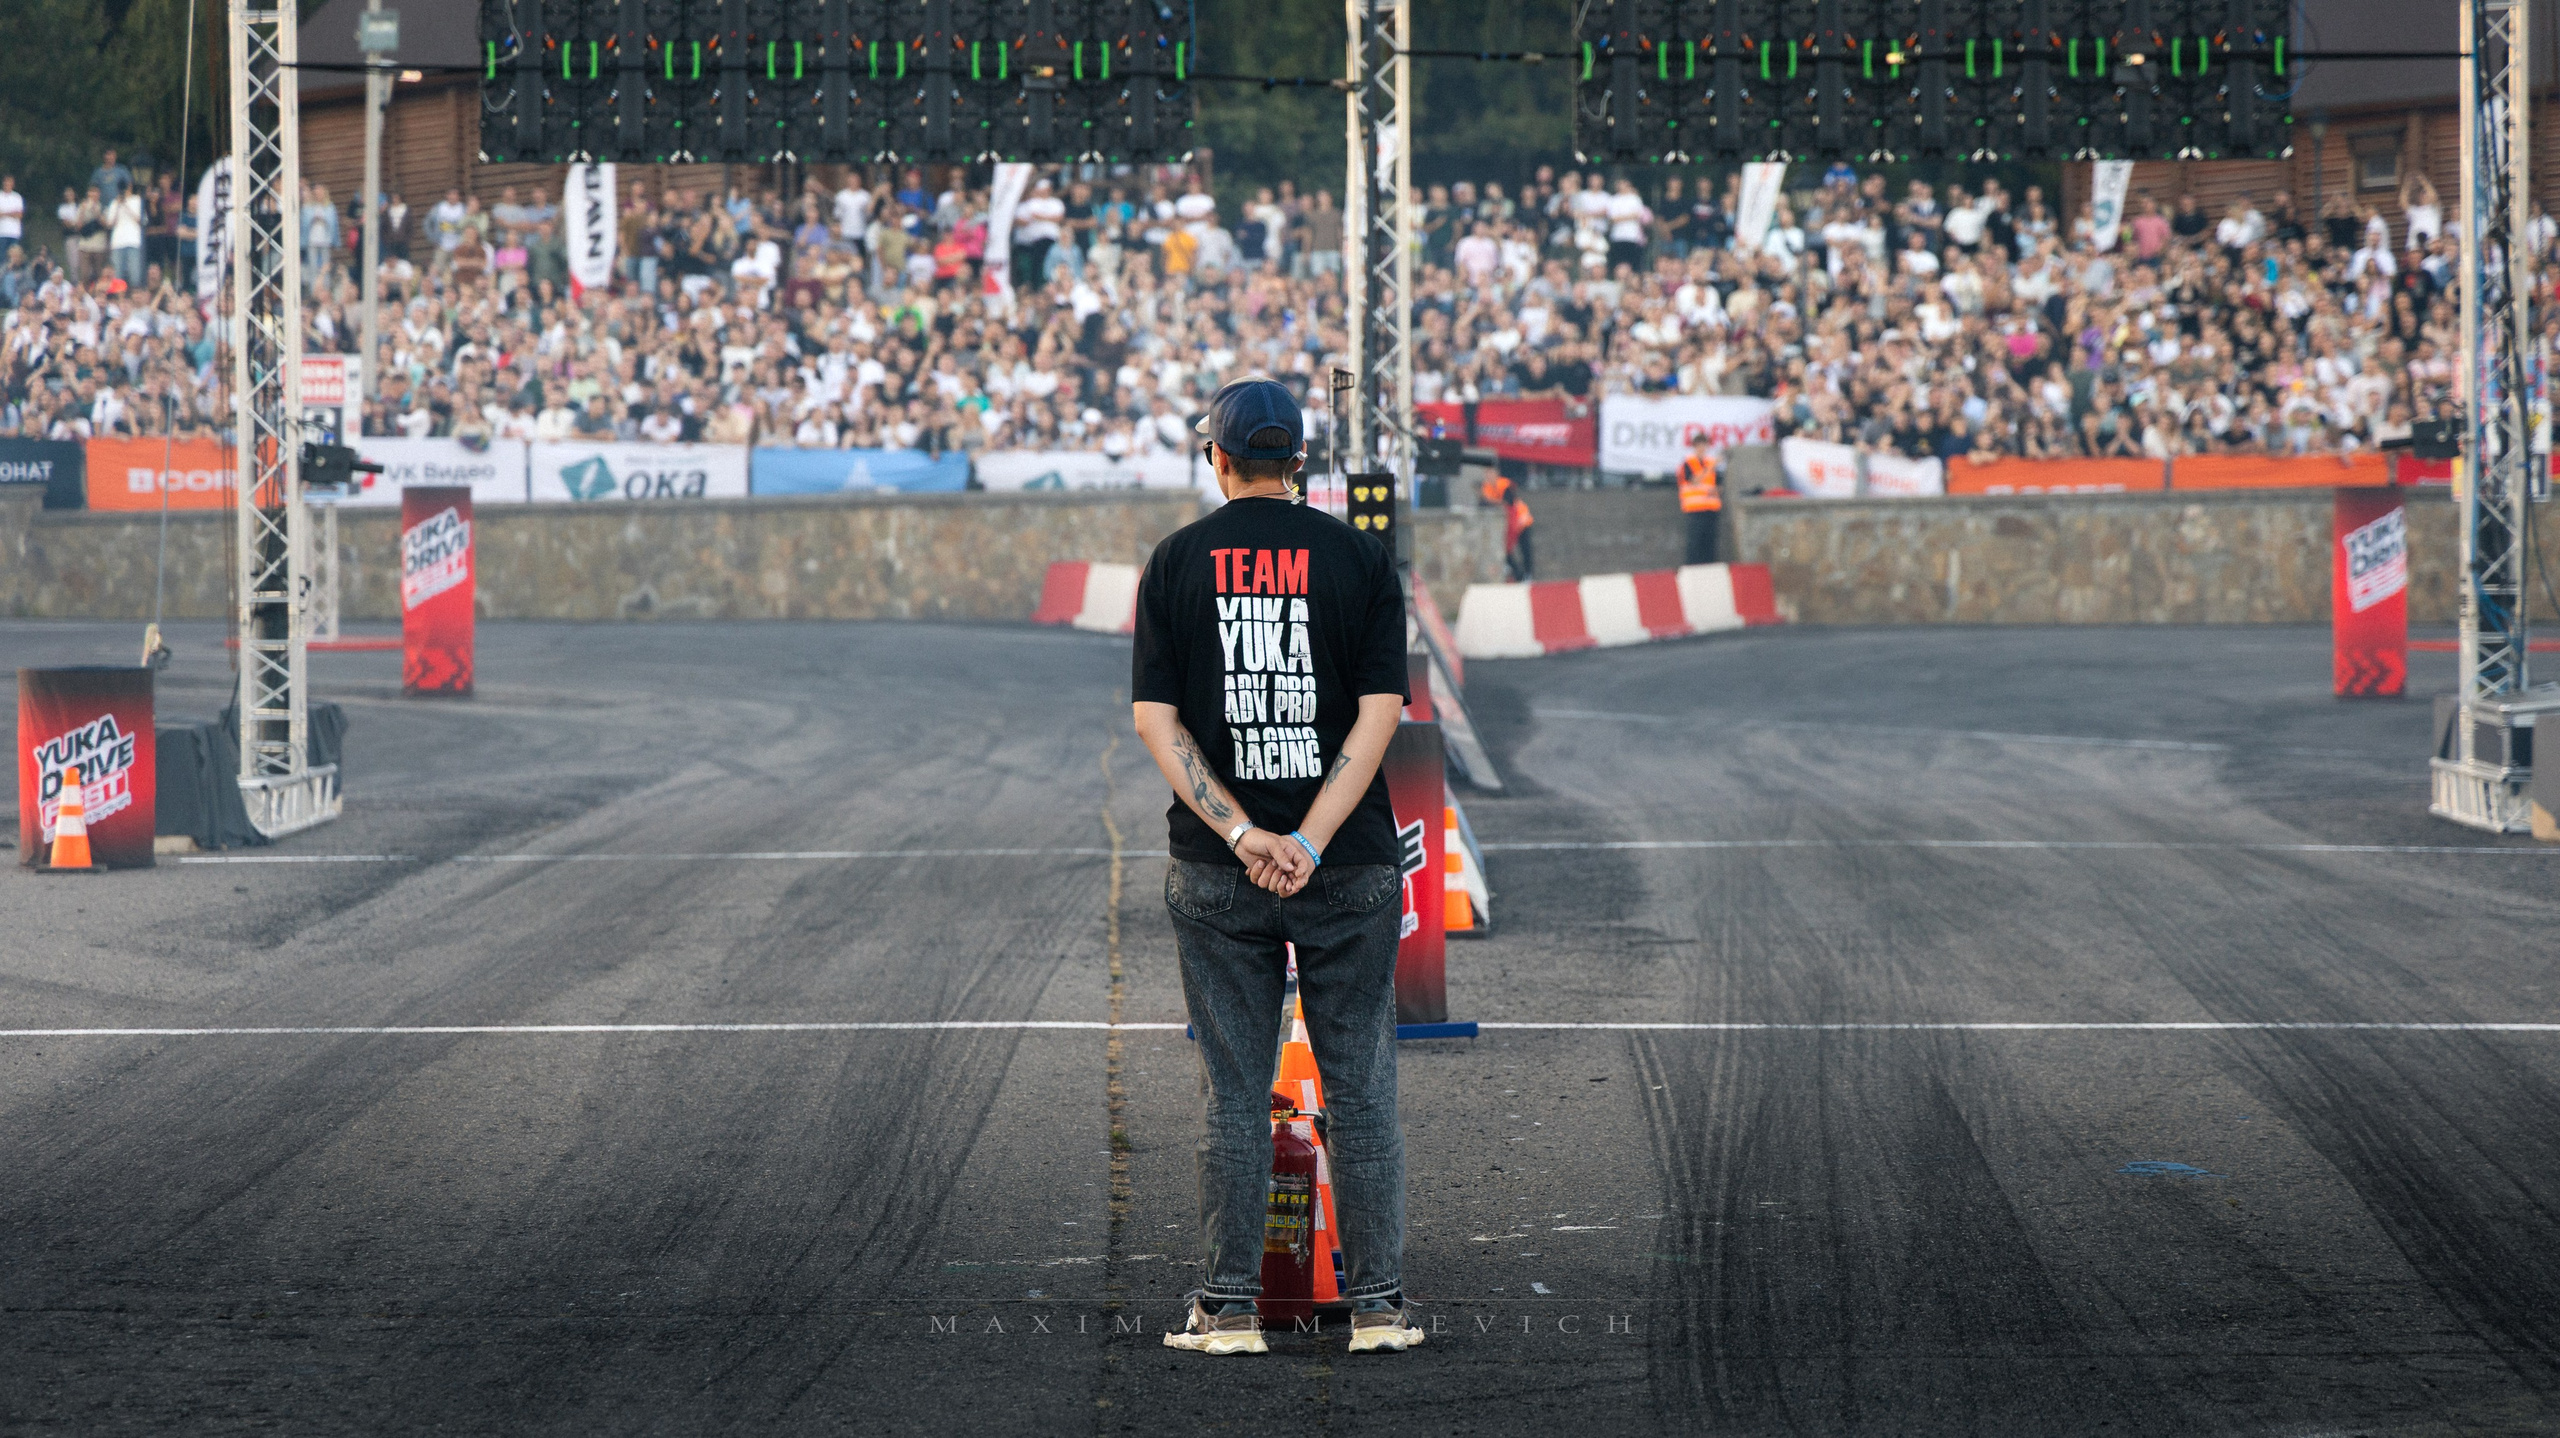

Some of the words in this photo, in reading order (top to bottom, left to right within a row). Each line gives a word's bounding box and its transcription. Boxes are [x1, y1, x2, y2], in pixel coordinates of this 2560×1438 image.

[1210, 548, 1310, 595] TEAM
[1217, 620, 1314, 673] YUKA
[1224, 689, 1268, 723] ADV
[1274, 690, 1317, 723] PRO
[36, 718, 118, 773] YUKA
[1234, 739, 1322, 780] RACING
[44, 771, 125, 827] FST
